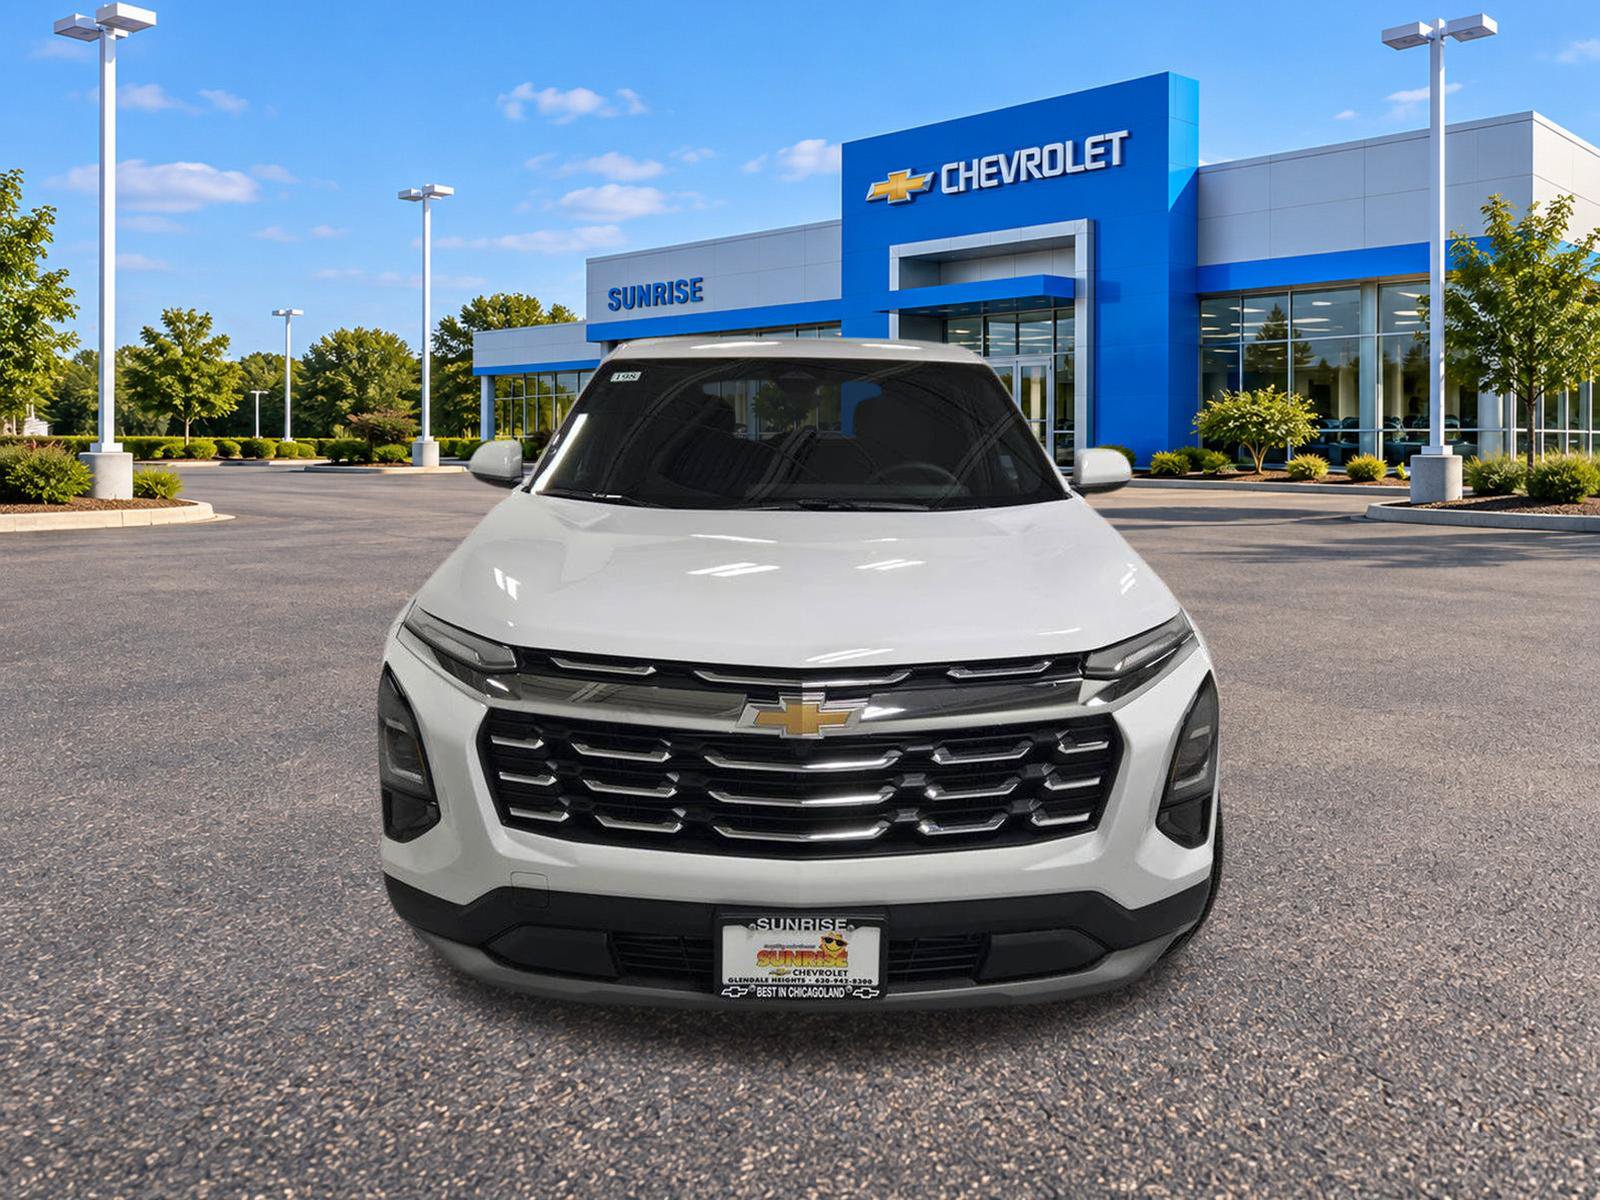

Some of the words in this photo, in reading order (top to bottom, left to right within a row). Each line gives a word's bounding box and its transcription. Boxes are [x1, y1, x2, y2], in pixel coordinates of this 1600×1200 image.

[941, 130, 1129, 194] CHEVROLET
[608, 277, 703, 311] SUNRISE
[756, 918, 847, 931] SUNRISE
[756, 950, 848, 967] SUNRISE
[792, 969, 848, 977] CHEVROLET
[756, 987, 775, 997] BEST
[778, 987, 786, 997] IN
[788, 987, 845, 998] CHICAGOLAND
